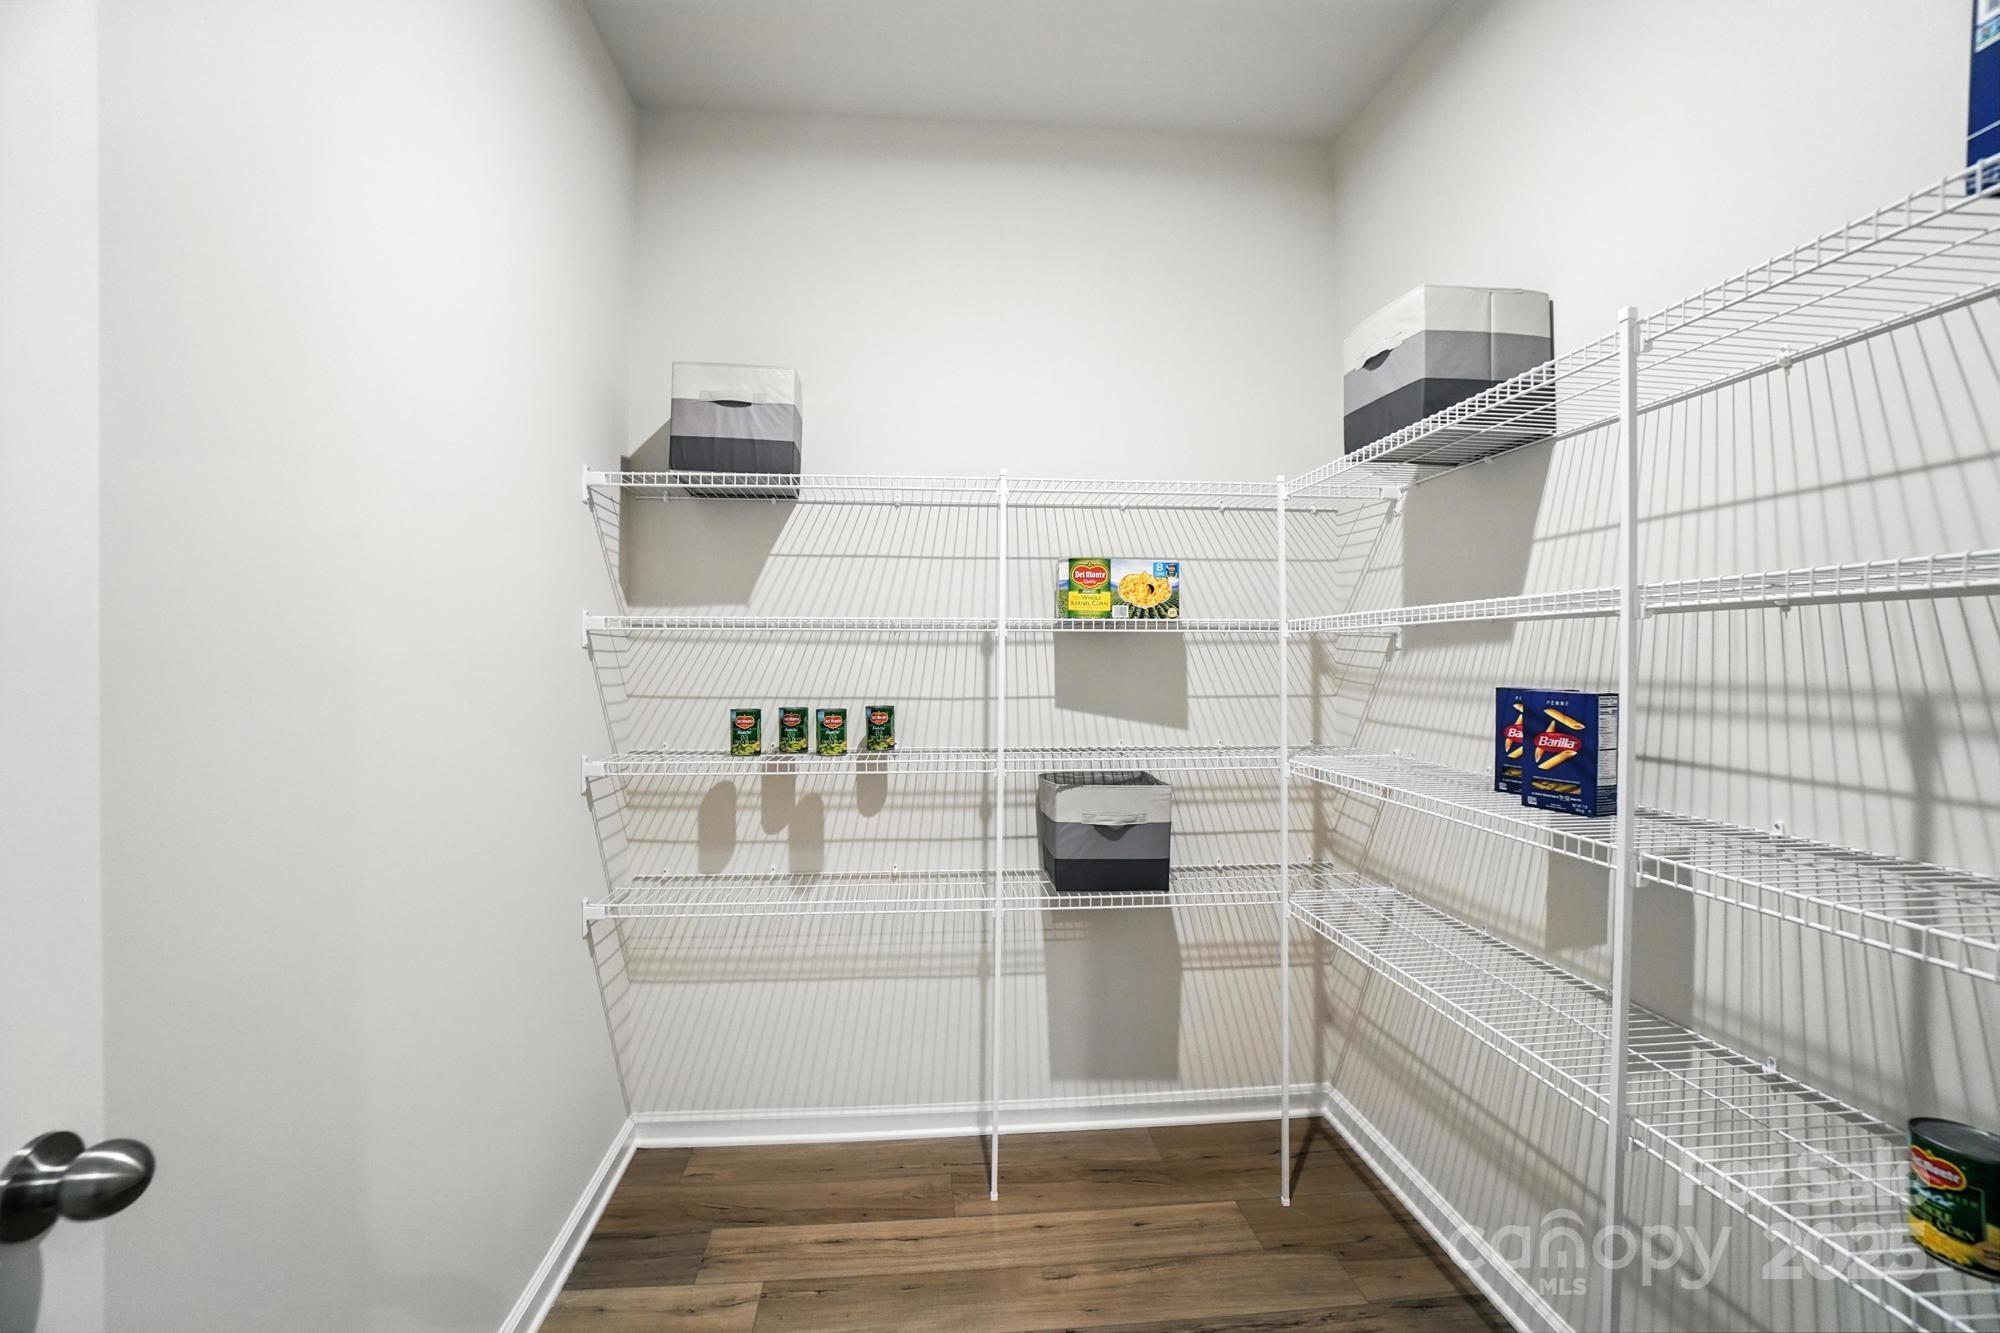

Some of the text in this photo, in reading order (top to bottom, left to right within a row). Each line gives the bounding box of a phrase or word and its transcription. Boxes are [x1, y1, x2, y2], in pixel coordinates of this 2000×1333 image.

[1156, 563, 1163, 572] 8
[1085, 571, 1106, 579] Monte
[1538, 736, 1575, 749] Barilla
